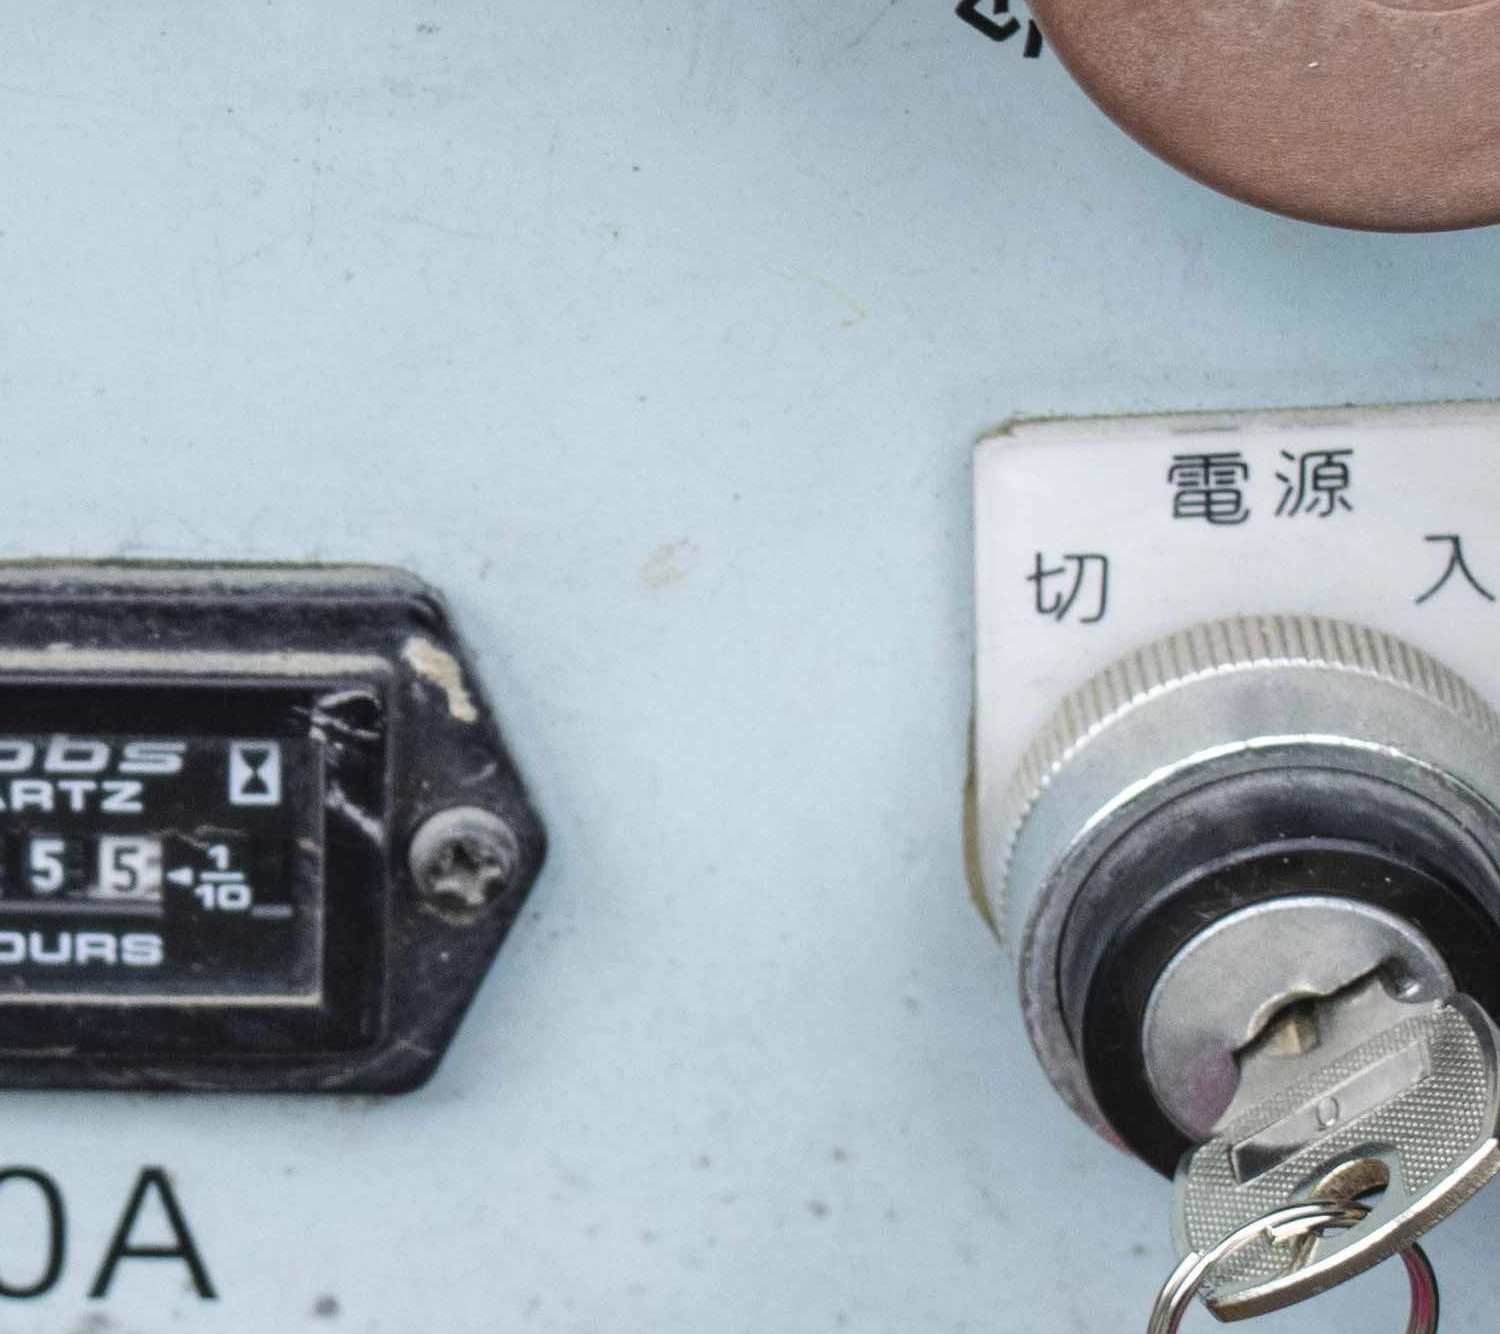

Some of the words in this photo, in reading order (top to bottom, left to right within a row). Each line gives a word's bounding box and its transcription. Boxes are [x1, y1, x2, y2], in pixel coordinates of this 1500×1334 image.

[1167, 449, 1354, 526] 電源
[1026, 552, 1109, 624] 切
[1415, 534, 1496, 604] 入
